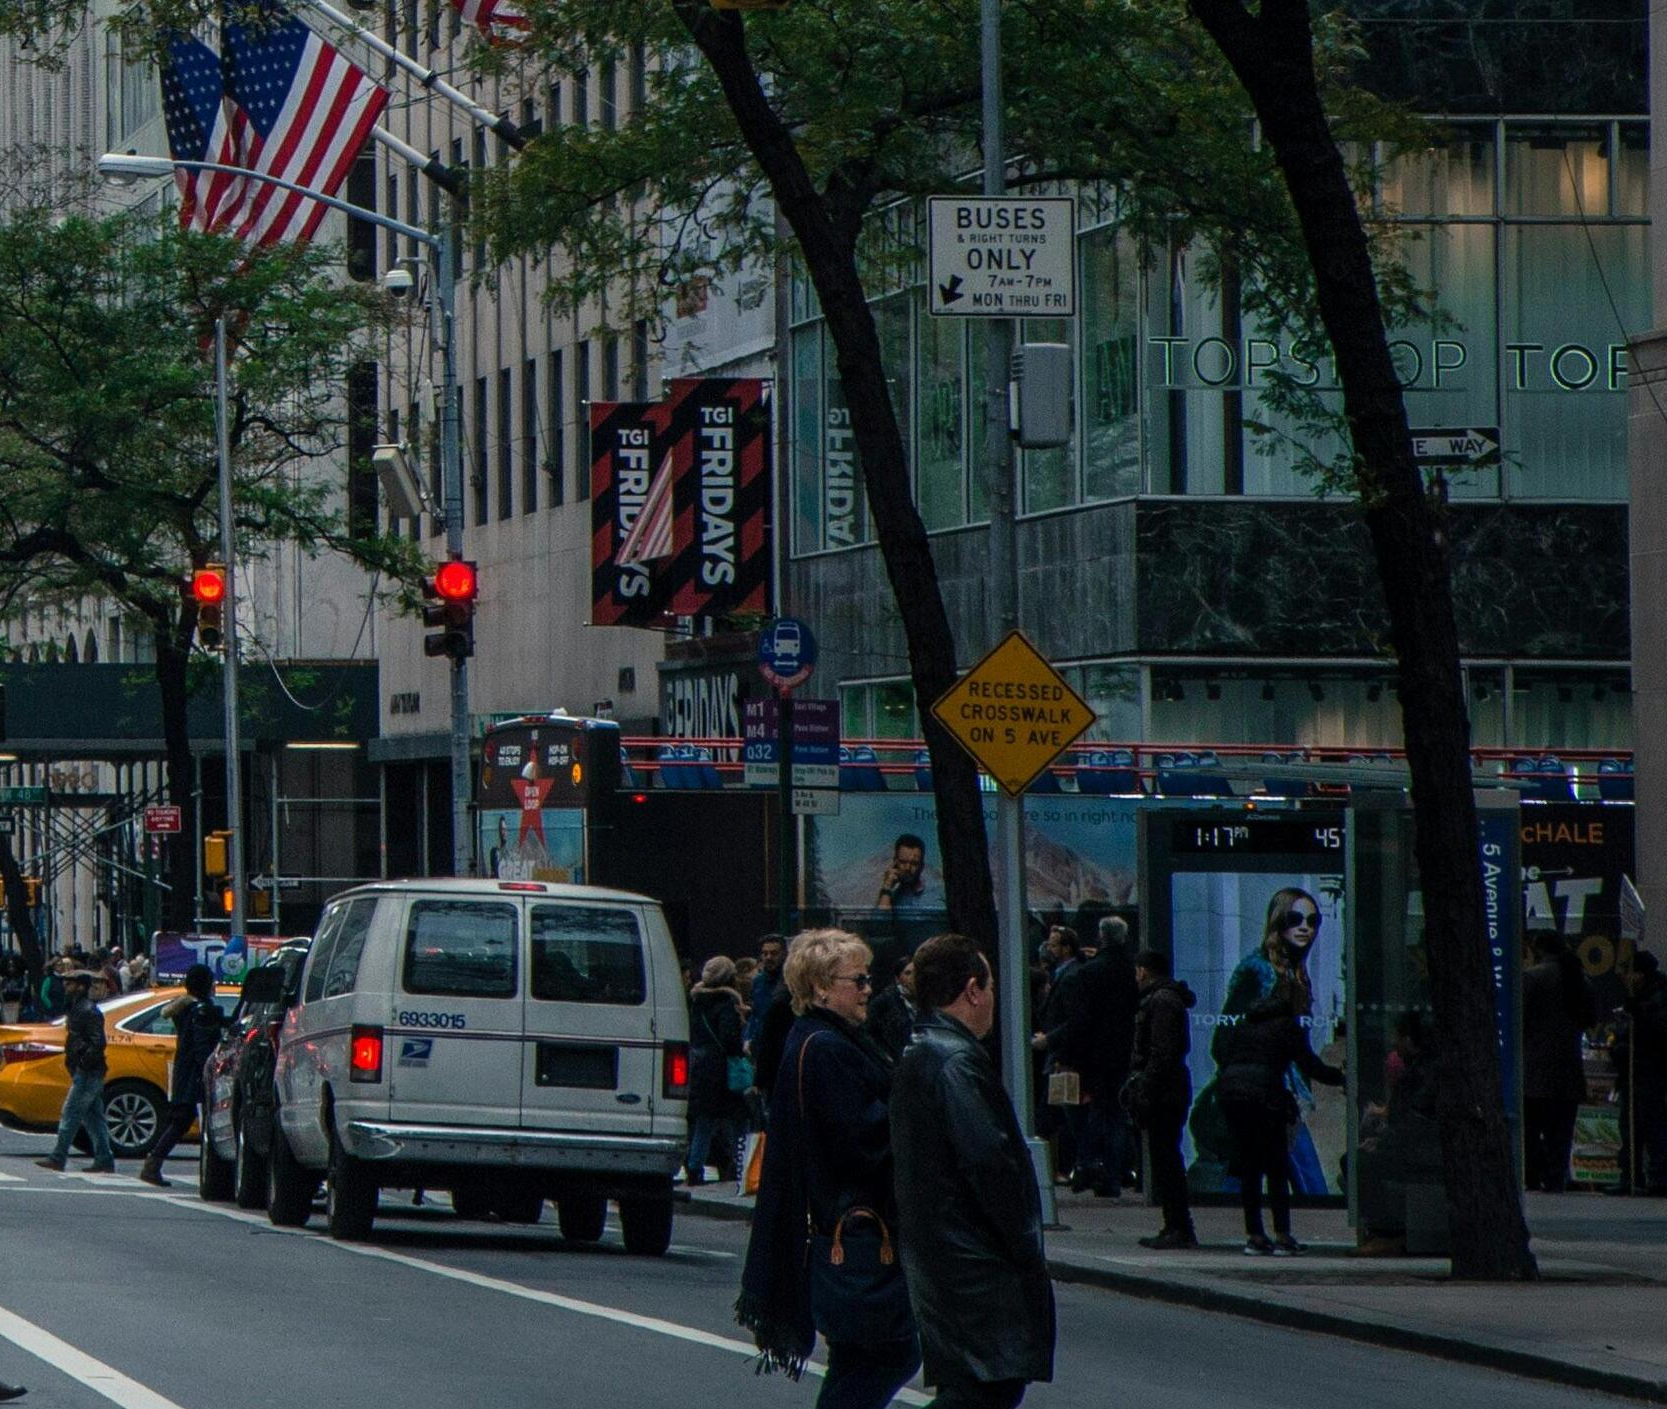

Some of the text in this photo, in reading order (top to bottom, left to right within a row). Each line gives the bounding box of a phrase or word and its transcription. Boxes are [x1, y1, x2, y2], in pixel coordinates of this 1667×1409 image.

[957, 207, 1045, 229] BUSES
[957, 233, 1047, 244] & RIGHT TURNS
[967, 248, 1036, 270] ONLY
[973, 293, 1067, 307] MON THRU FRI
[1148, 336, 1467, 388] TOPSOP
[701, 406, 734, 423] TGI
[618, 429, 649, 445] TGI
[1450, 439, 1487, 454] WAY
[701, 427, 735, 585] FRIDAYS
[618, 448, 651, 598] FRIDS
[969, 681, 1064, 701] RECESSED
[747, 702, 764, 716] M1
[960, 704, 1072, 724] CROSSWALK
[747, 723, 765, 738] M4
[971, 727, 1062, 746] ON 5 AVE
[1522, 822, 1604, 844] cHALE
[399, 1010, 466, 1029] 6933015
